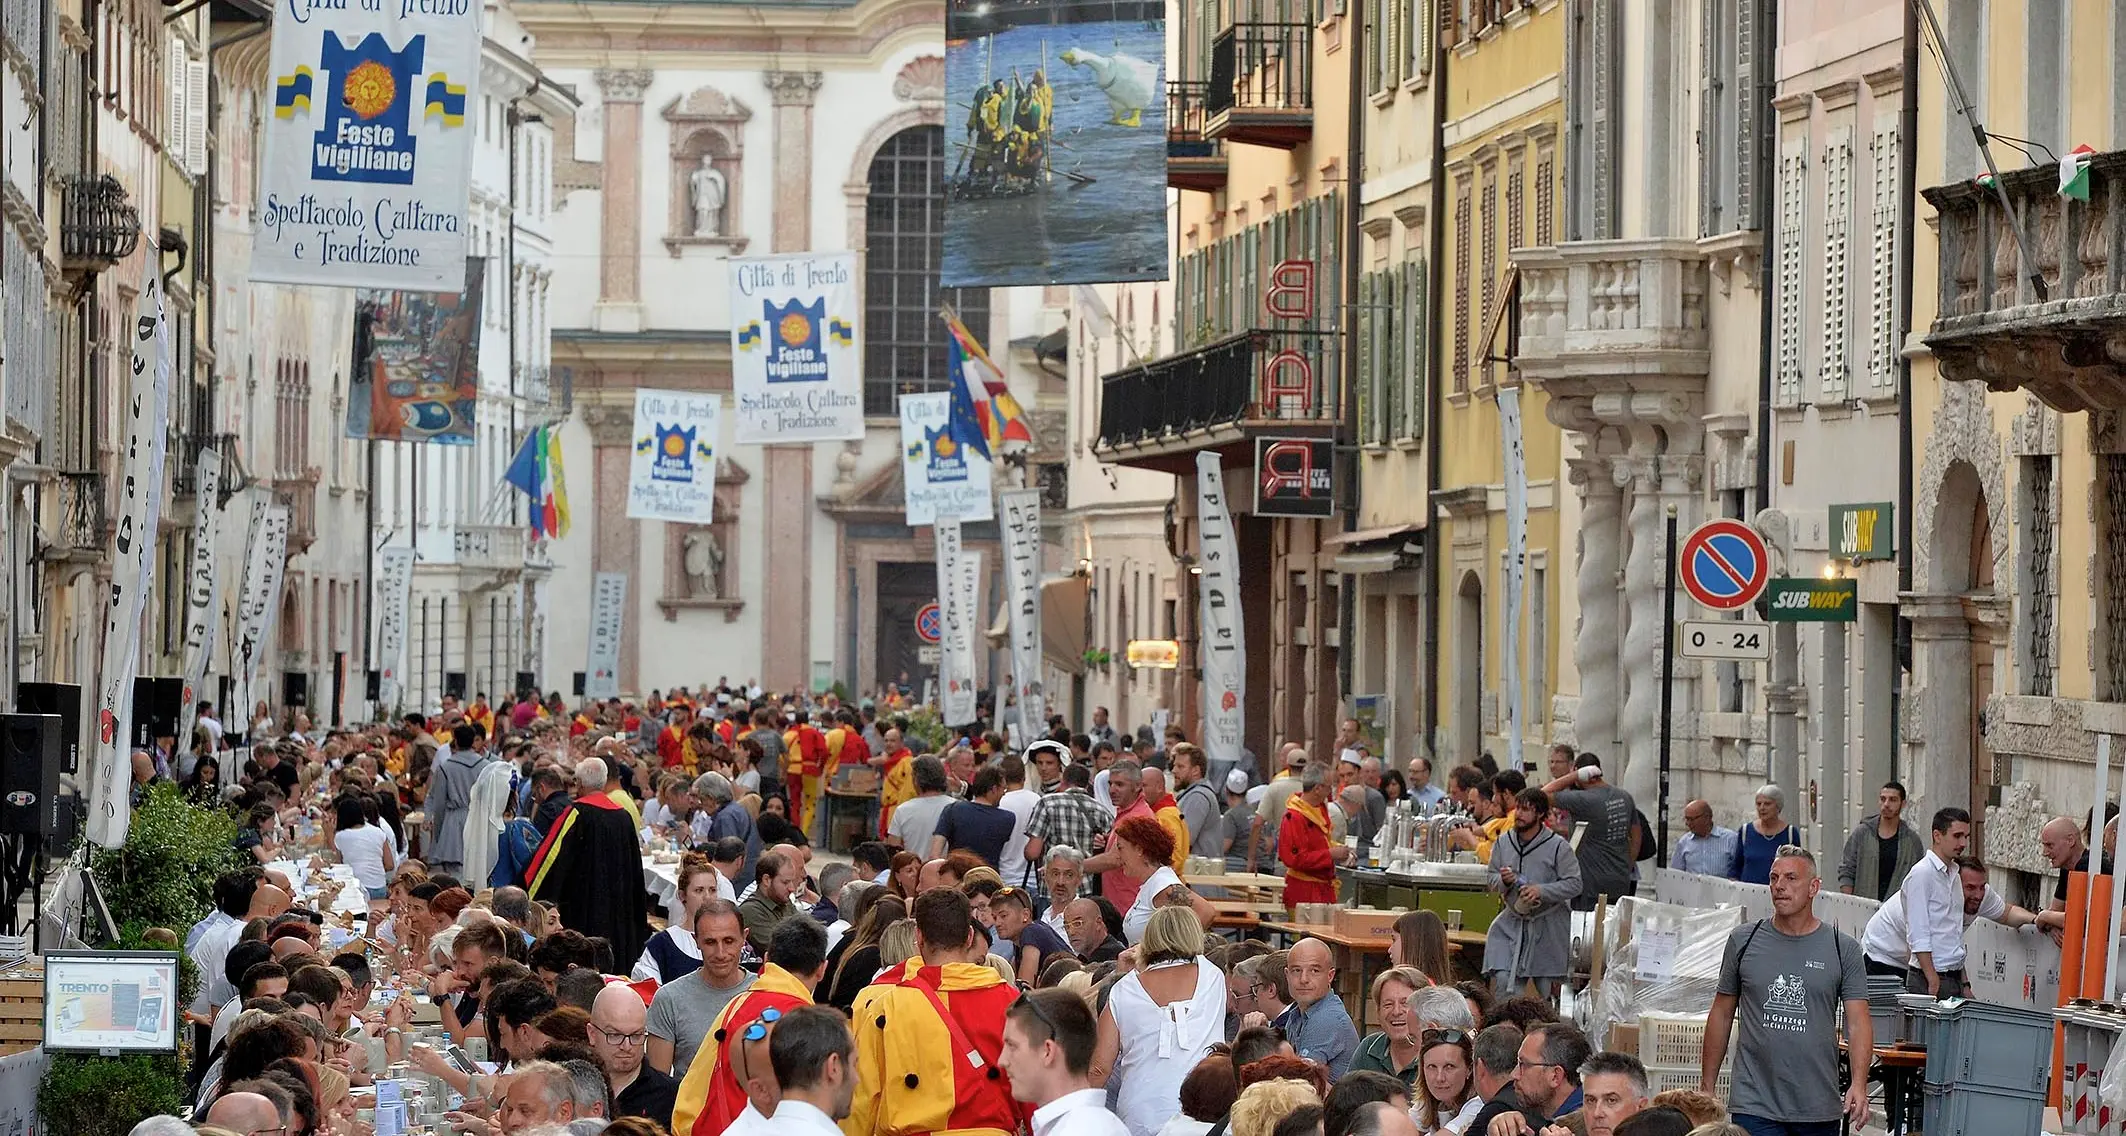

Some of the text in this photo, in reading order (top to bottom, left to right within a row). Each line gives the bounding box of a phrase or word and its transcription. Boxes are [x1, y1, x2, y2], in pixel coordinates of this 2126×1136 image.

[337, 117, 395, 147] Feste
[317, 143, 413, 174] Vigiliane
[264, 193, 458, 241] Spettacolo, Cultura
[294, 231, 420, 267] e Tradizione
[782, 262, 795, 287] di
[803, 260, 848, 289] Trento
[778, 347, 814, 361] Feste
[768, 360, 827, 378] Vigiliane
[1841, 510, 1878, 553] SUBWAY
[1772, 591, 1853, 610] SUBWAY
[1692, 632, 1705, 647] 0
[1733, 633, 1760, 649] 24
[59, 983, 109, 993] TRENTO
